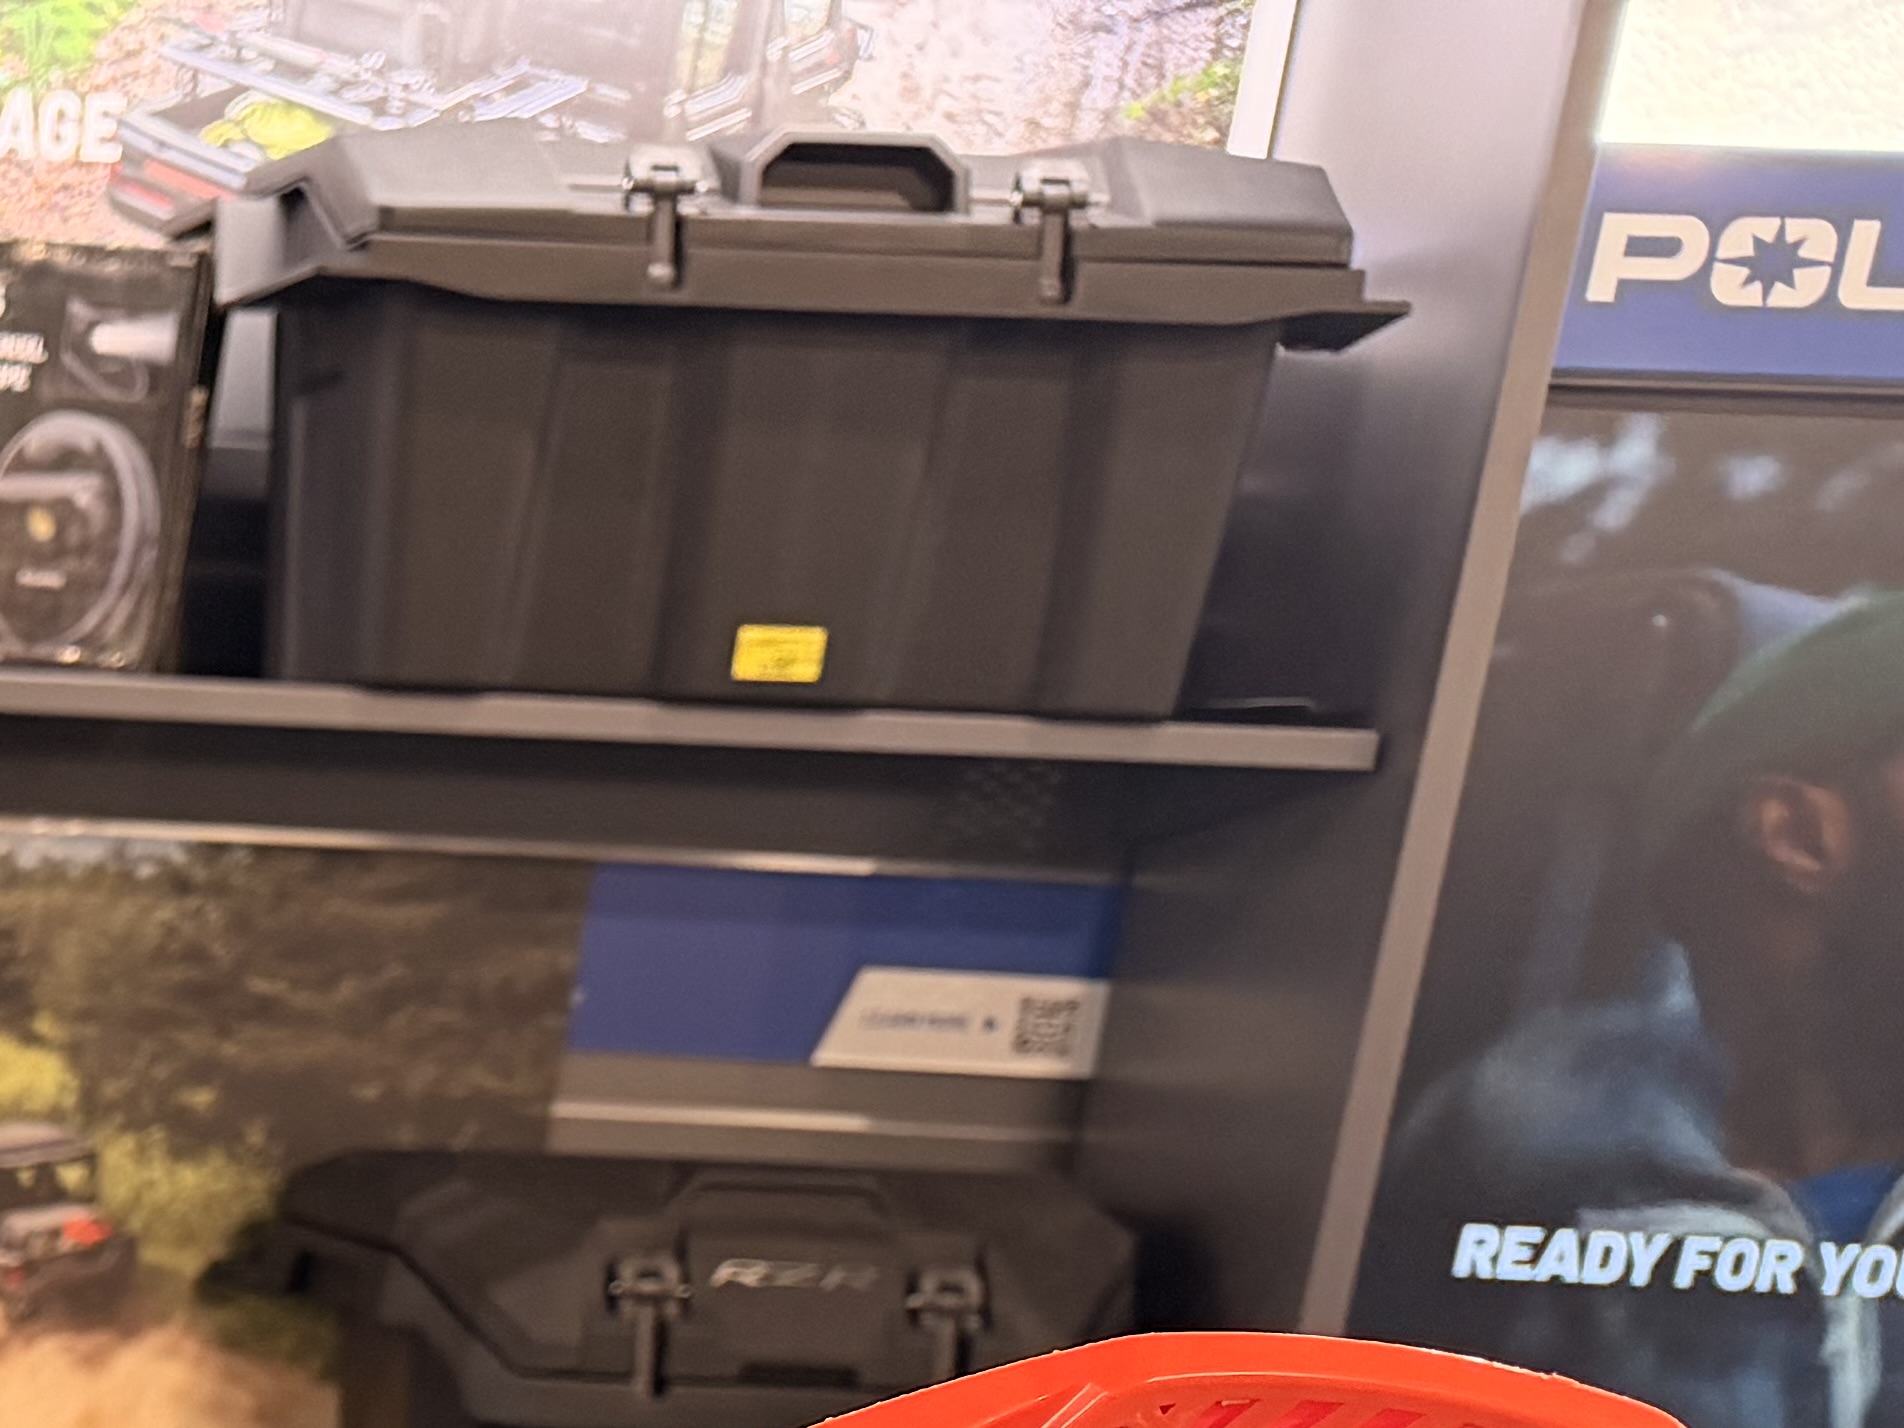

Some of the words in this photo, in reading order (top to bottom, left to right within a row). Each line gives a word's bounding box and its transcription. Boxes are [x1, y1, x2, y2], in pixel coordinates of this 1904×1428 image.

[1451, 1222, 1674, 1288] READY
[1673, 1235, 1804, 1295] FOR
[1819, 1241, 1904, 1299] YO
